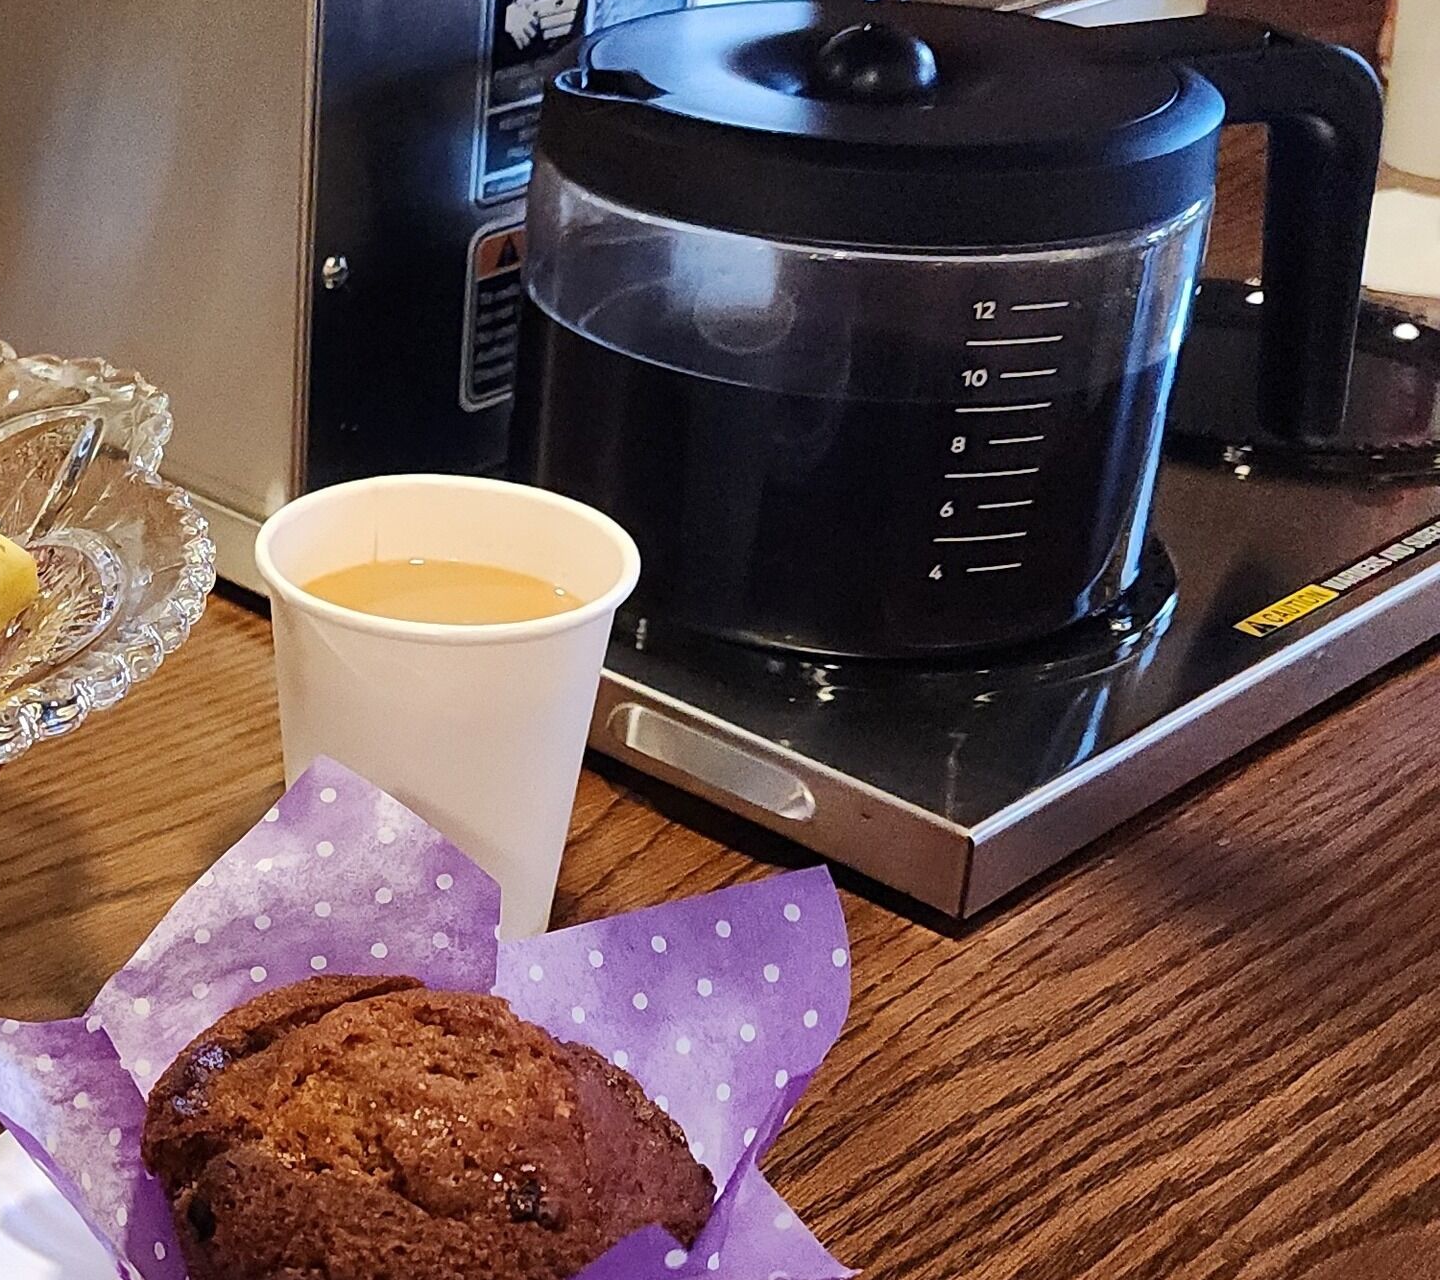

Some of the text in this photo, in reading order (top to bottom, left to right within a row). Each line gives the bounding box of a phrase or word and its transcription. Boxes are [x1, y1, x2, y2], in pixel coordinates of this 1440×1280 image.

[972, 300, 997, 320] 12
[961, 368, 988, 387] 10
[950, 435, 966, 454] 8
[939, 501, 954, 518] 6
[928, 564, 943, 581] 4
[1262, 588, 1330, 624] CAUTION
